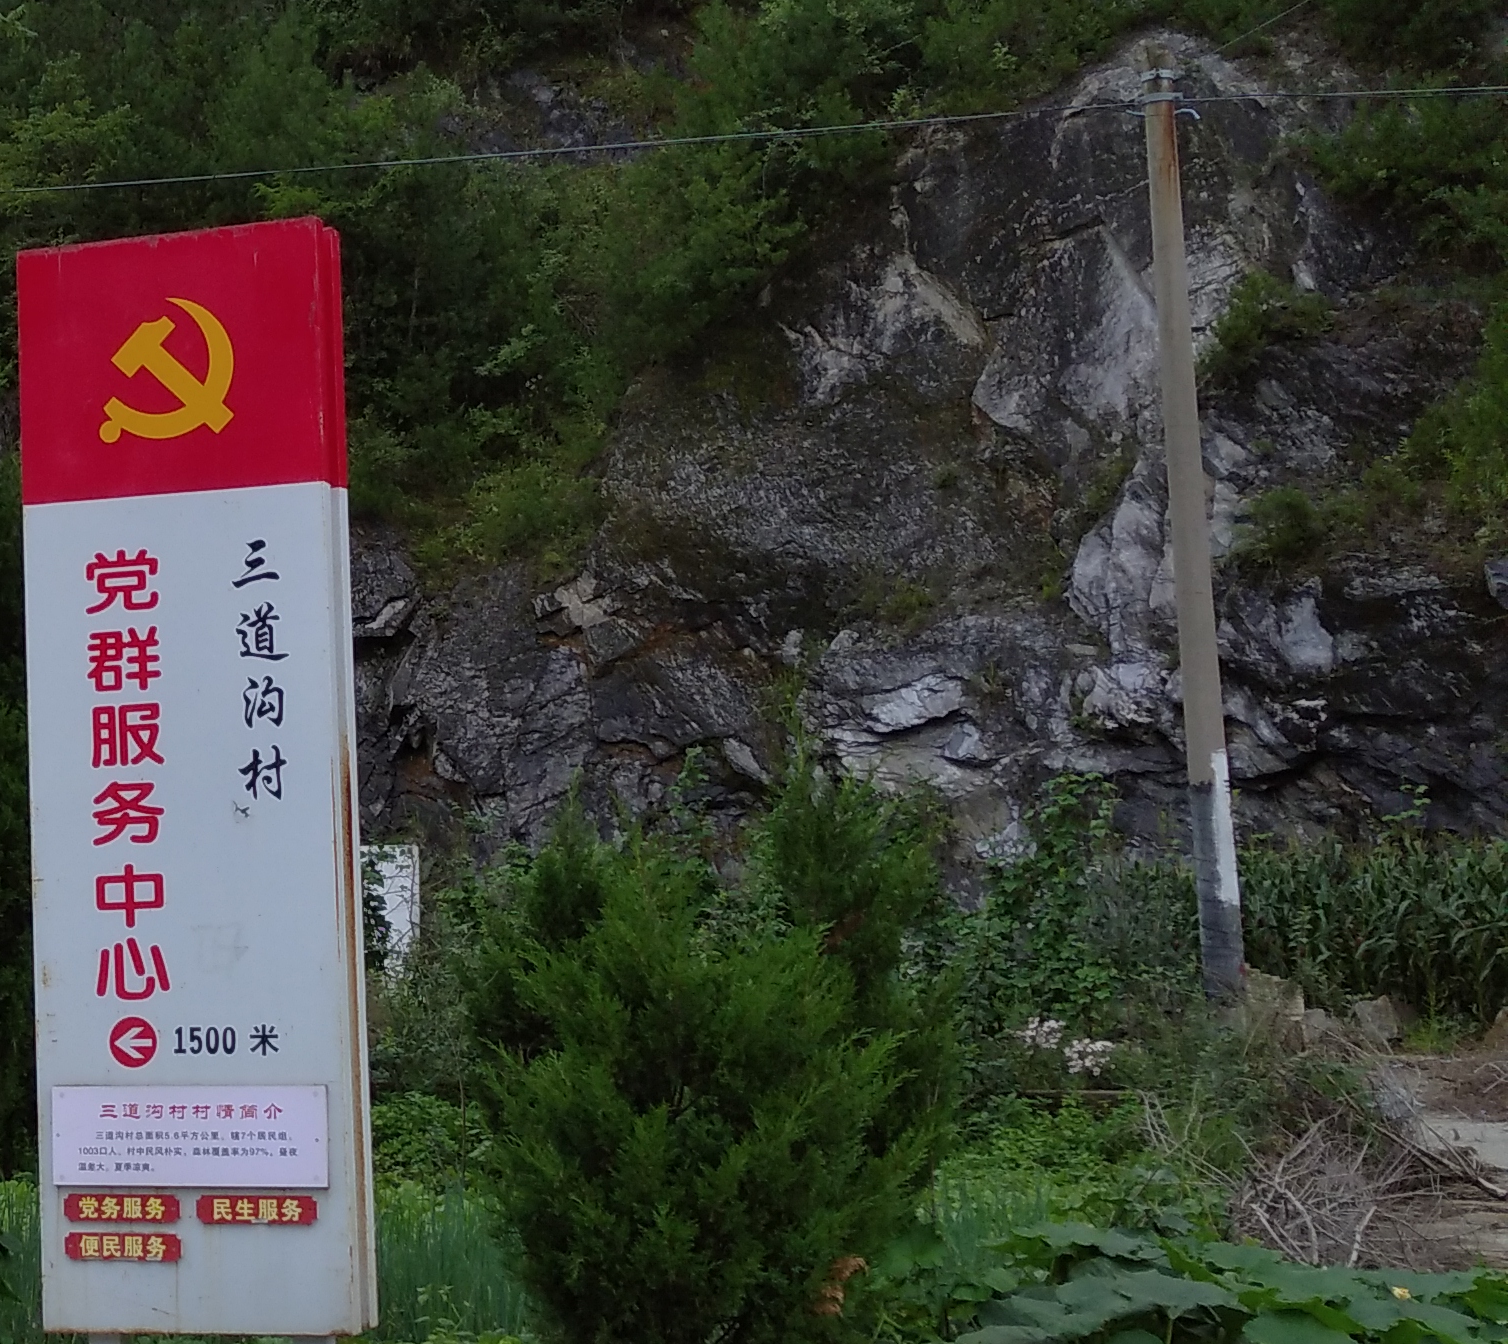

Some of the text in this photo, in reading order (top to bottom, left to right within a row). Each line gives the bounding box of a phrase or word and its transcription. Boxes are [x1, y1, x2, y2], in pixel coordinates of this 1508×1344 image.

[231, 539, 289, 801] 三道沟村
[84, 548, 171, 1001] 党群服务中心
[173, 1024, 280, 1056] 1500 米
[99, 1103, 284, 1121] 三道沟村村情简介
[78, 1197, 166, 1219] 党务服务
[212, 1199, 303, 1222] 民生服务
[80, 1235, 167, 1259] 便民服务
